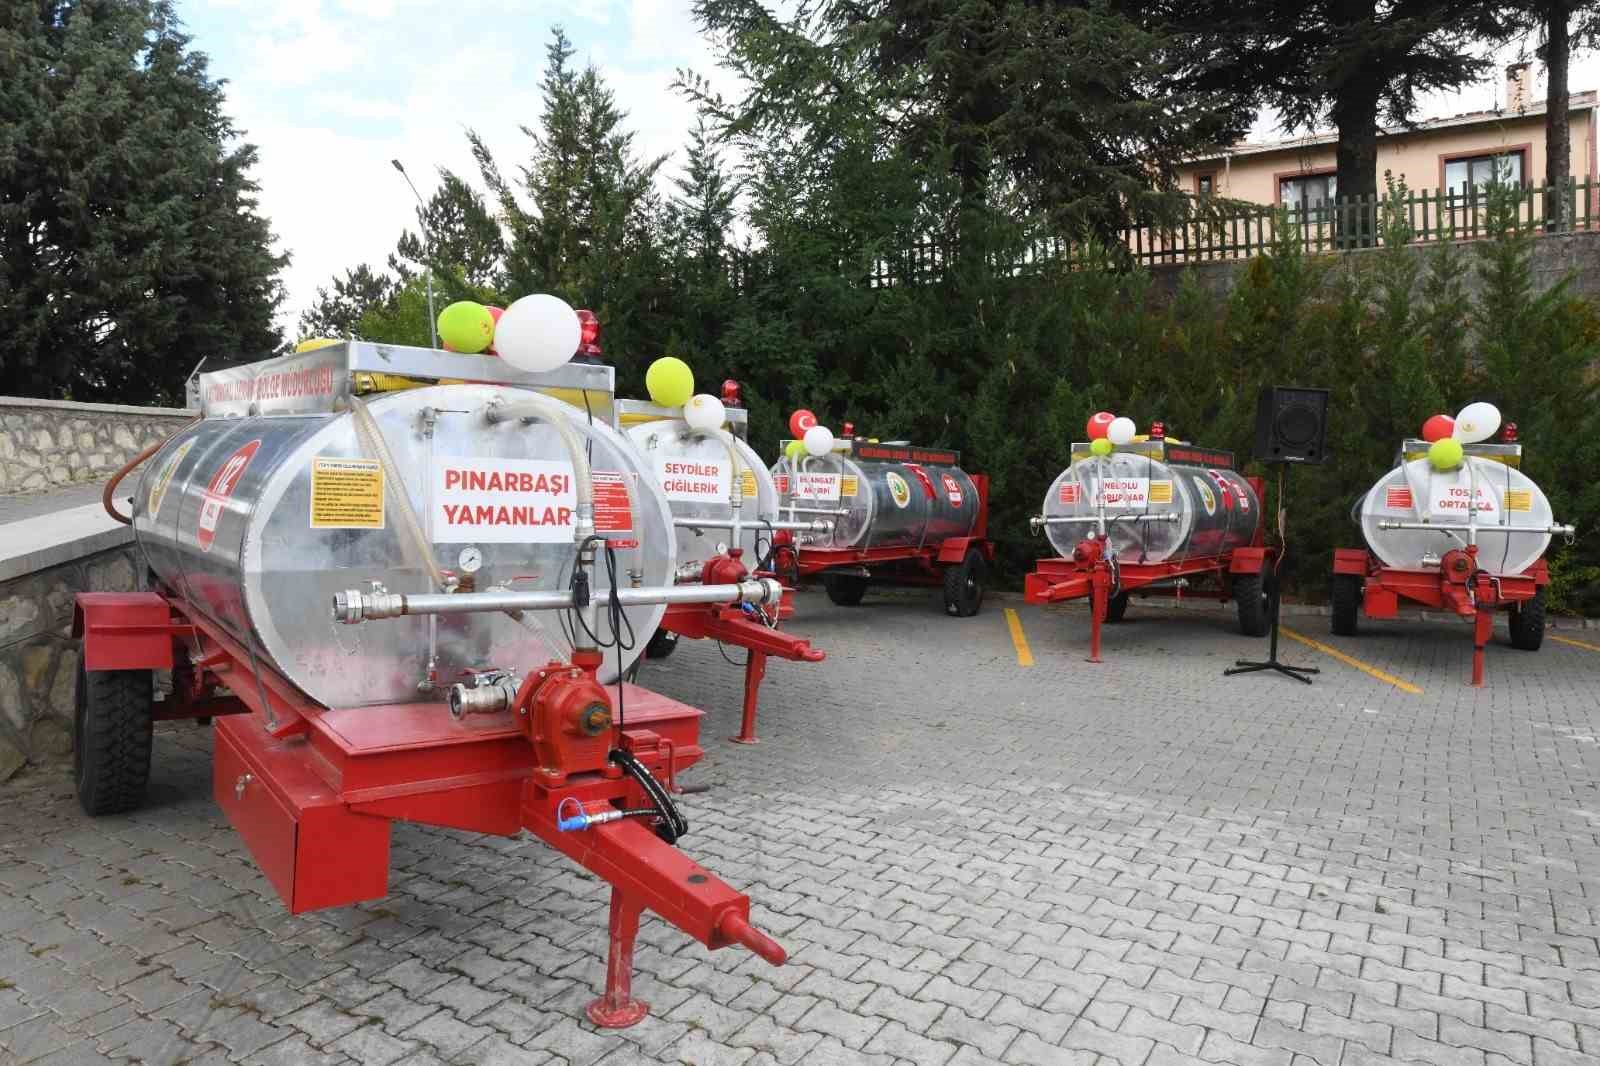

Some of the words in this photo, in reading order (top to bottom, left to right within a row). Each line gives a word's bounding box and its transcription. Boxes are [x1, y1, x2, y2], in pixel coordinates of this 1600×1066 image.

[664, 462, 719, 477] SEYDİLER
[444, 469, 570, 496] PINARBAŞI
[1448, 487, 1483, 497] TOSA
[442, 504, 571, 526] YAMANLAR
